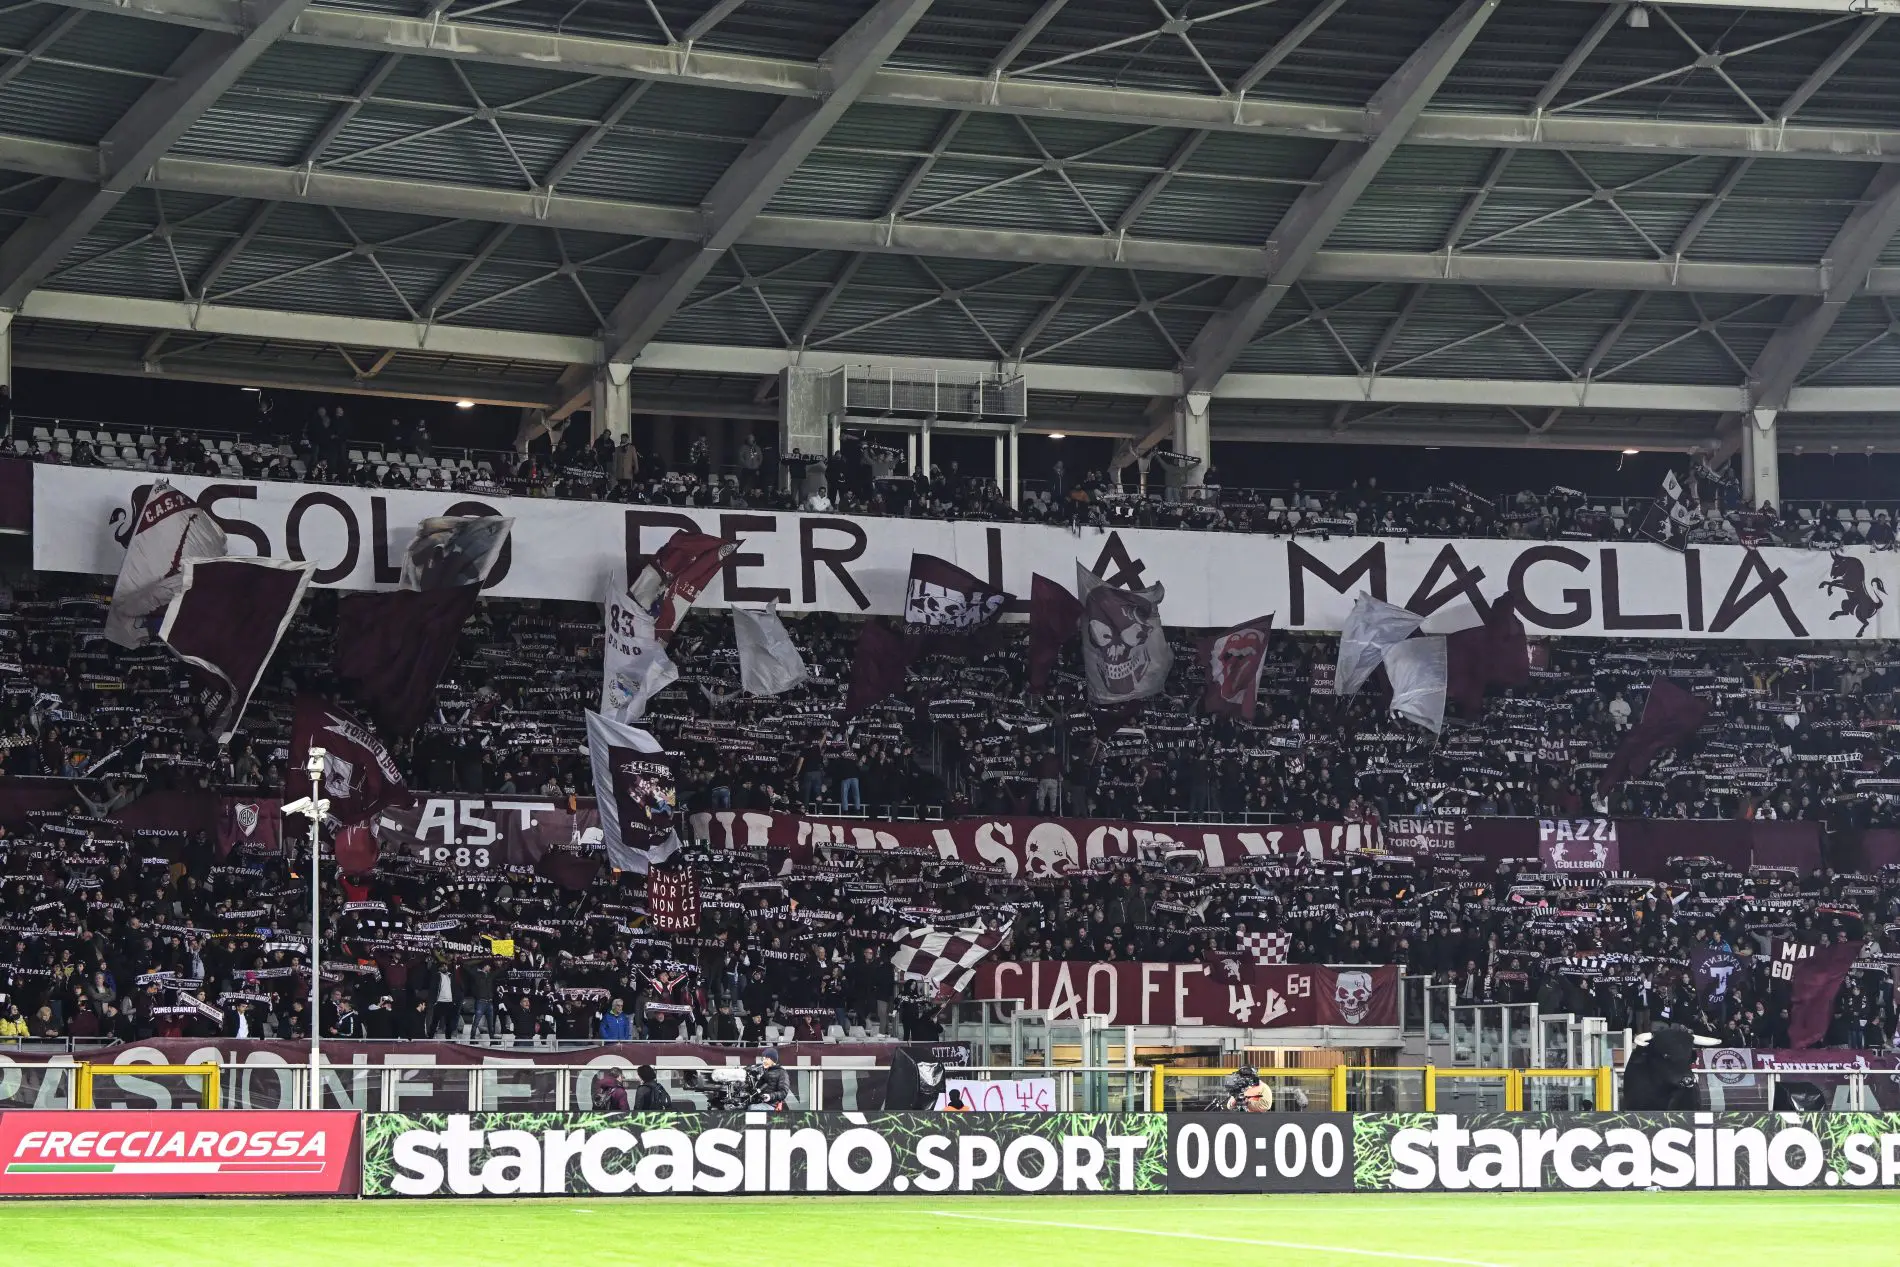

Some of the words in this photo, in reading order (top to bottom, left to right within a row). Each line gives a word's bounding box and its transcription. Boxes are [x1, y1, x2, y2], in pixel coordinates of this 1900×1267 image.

[625, 510, 871, 610] PER
[1287, 541, 1809, 637] MAGLIA
[1541, 737, 1565, 750] MAI
[1537, 749, 1569, 761] SOLI
[137, 828, 180, 838] GENOVA
[1389, 819, 1456, 836] RENATE
[1538, 819, 1617, 842] PAZZI
[1389, 837, 1417, 849] TORO
[1428, 838, 1456, 849] CLUB
[419, 847, 490, 868] 1983
[1557, 860, 1603, 869] COLLEGNO
[652, 881, 694, 899] MORTE
[651, 898, 674, 912] NON
[682, 897, 696, 911] CI
[1767, 899, 1790, 907] TORINO
[538, 919, 585, 927] TORINO
[652, 913, 697, 930] SEPARI
[443, 940, 471, 952] TORINO
[472, 945, 485, 953] FC
[994, 961, 1119, 1025] CIAO
[1287, 973, 1311, 998] 69
[152, 1006, 172, 1014] CUNEO
[172, 1006, 198, 1014] GRANATA
[794, 1007, 828, 1015] GRANATA
[1757, 1053, 1853, 1073] TENNENT'S
[13, 1130, 327, 1158] FRECCIAROSSA
[1176, 1122, 1345, 1179] 00:00
